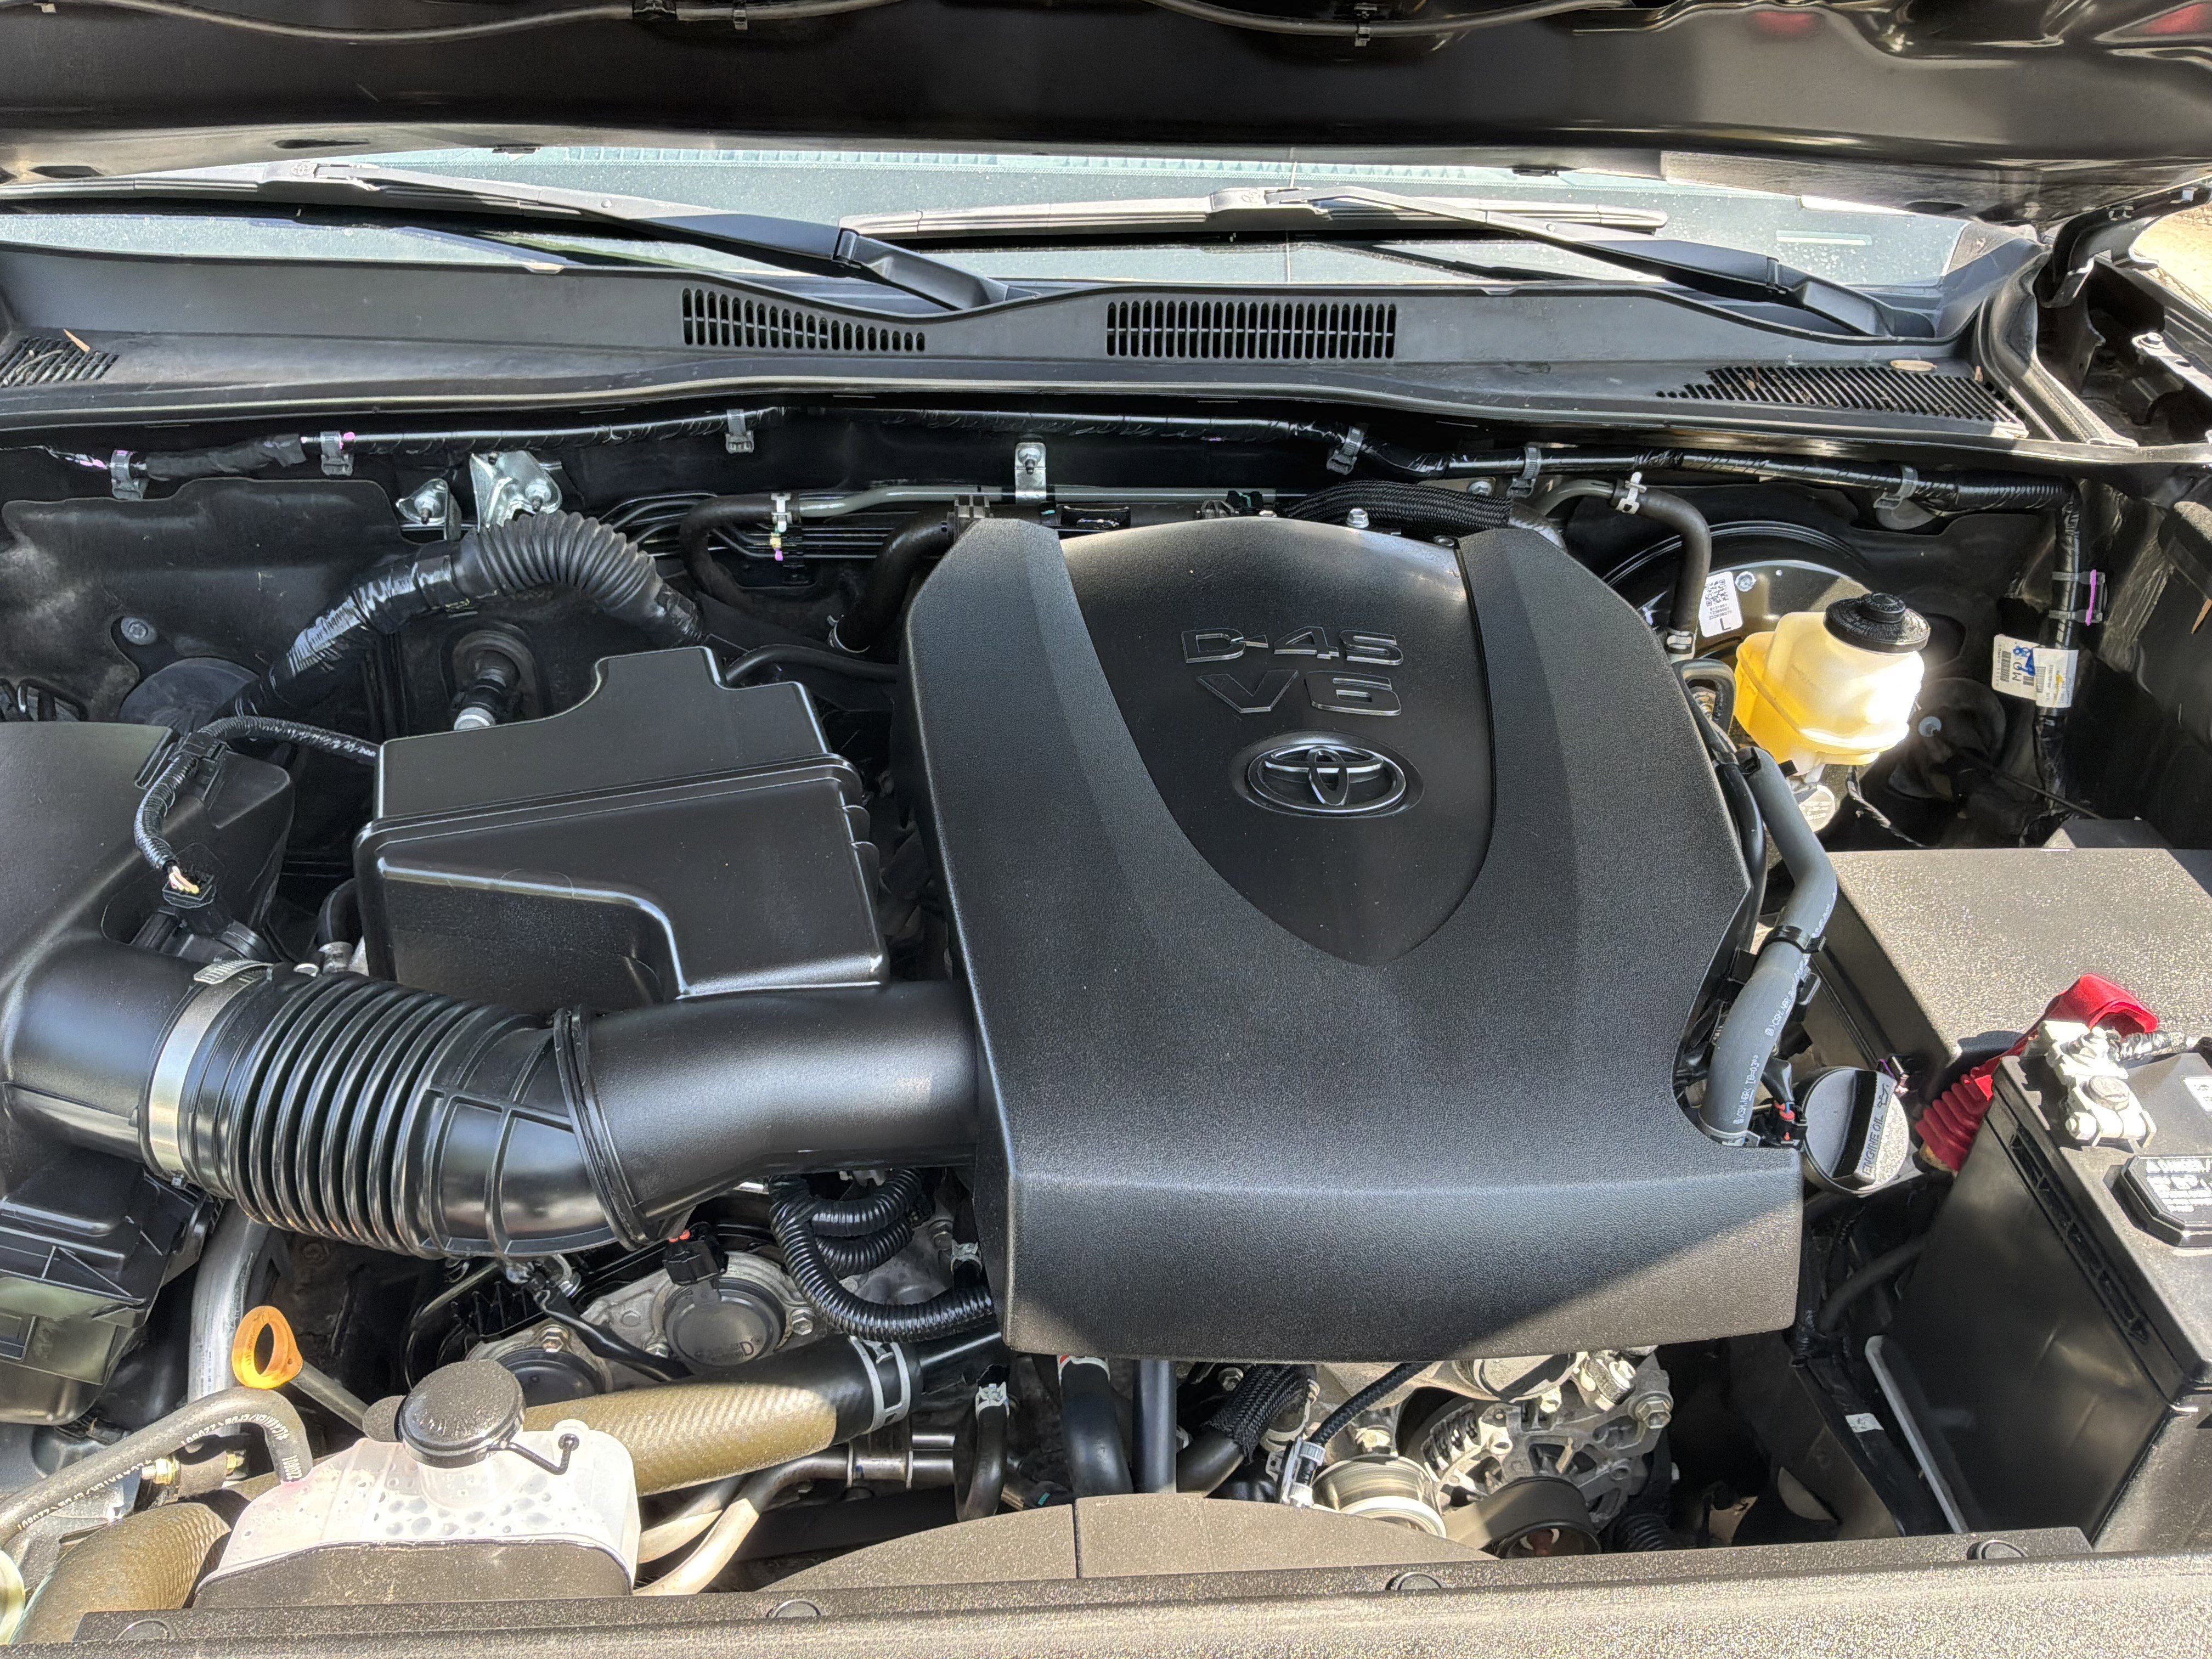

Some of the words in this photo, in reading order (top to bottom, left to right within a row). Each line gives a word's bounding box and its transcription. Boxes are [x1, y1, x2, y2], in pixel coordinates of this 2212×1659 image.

[1720, 618, 1731, 631] L
[1181, 626, 1403, 665] D-4S
[1197, 669, 1401, 716] V6
[1862, 1133, 1881, 1178] ENGINE
[1875, 1114, 1884, 1133] OIL
[739, 1341, 754, 1356] D
